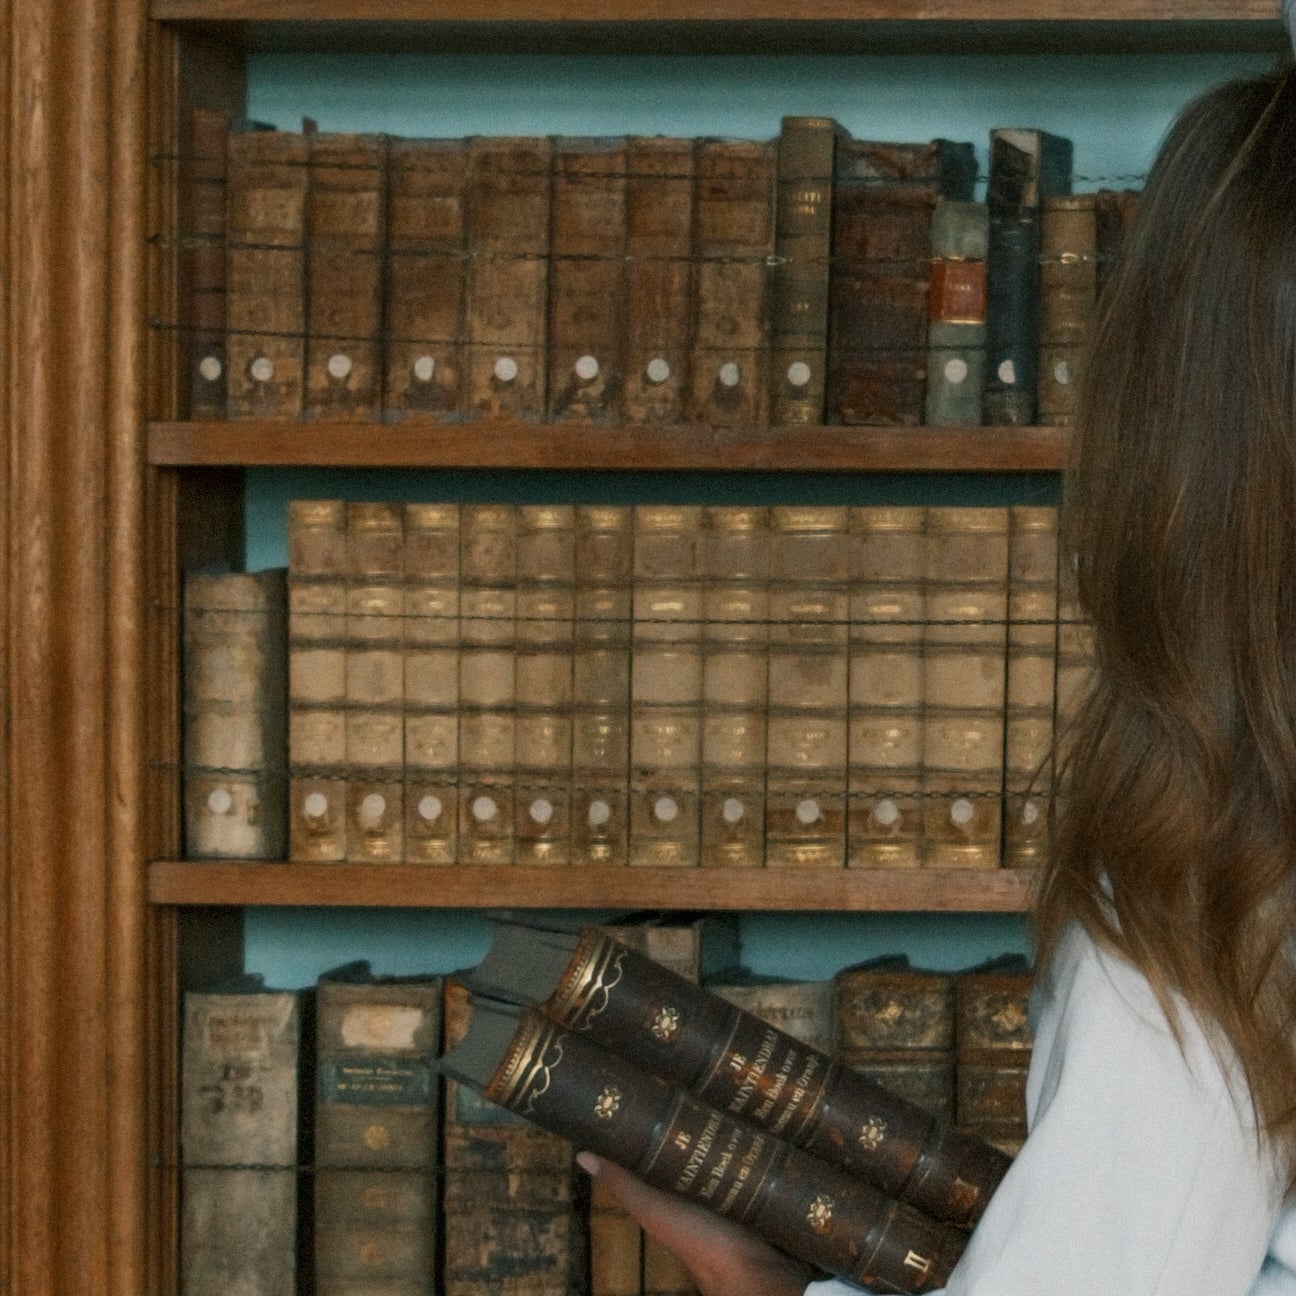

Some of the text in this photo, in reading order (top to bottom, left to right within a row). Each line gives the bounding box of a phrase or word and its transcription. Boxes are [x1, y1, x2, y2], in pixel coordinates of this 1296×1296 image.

[726, 1051, 747, 1071] JE
[766, 1072, 788, 1100] Boek
[675, 1130, 692, 1150] JE
[711, 1151, 734, 1180] Boek
[904, 1250, 931, 1274] II
